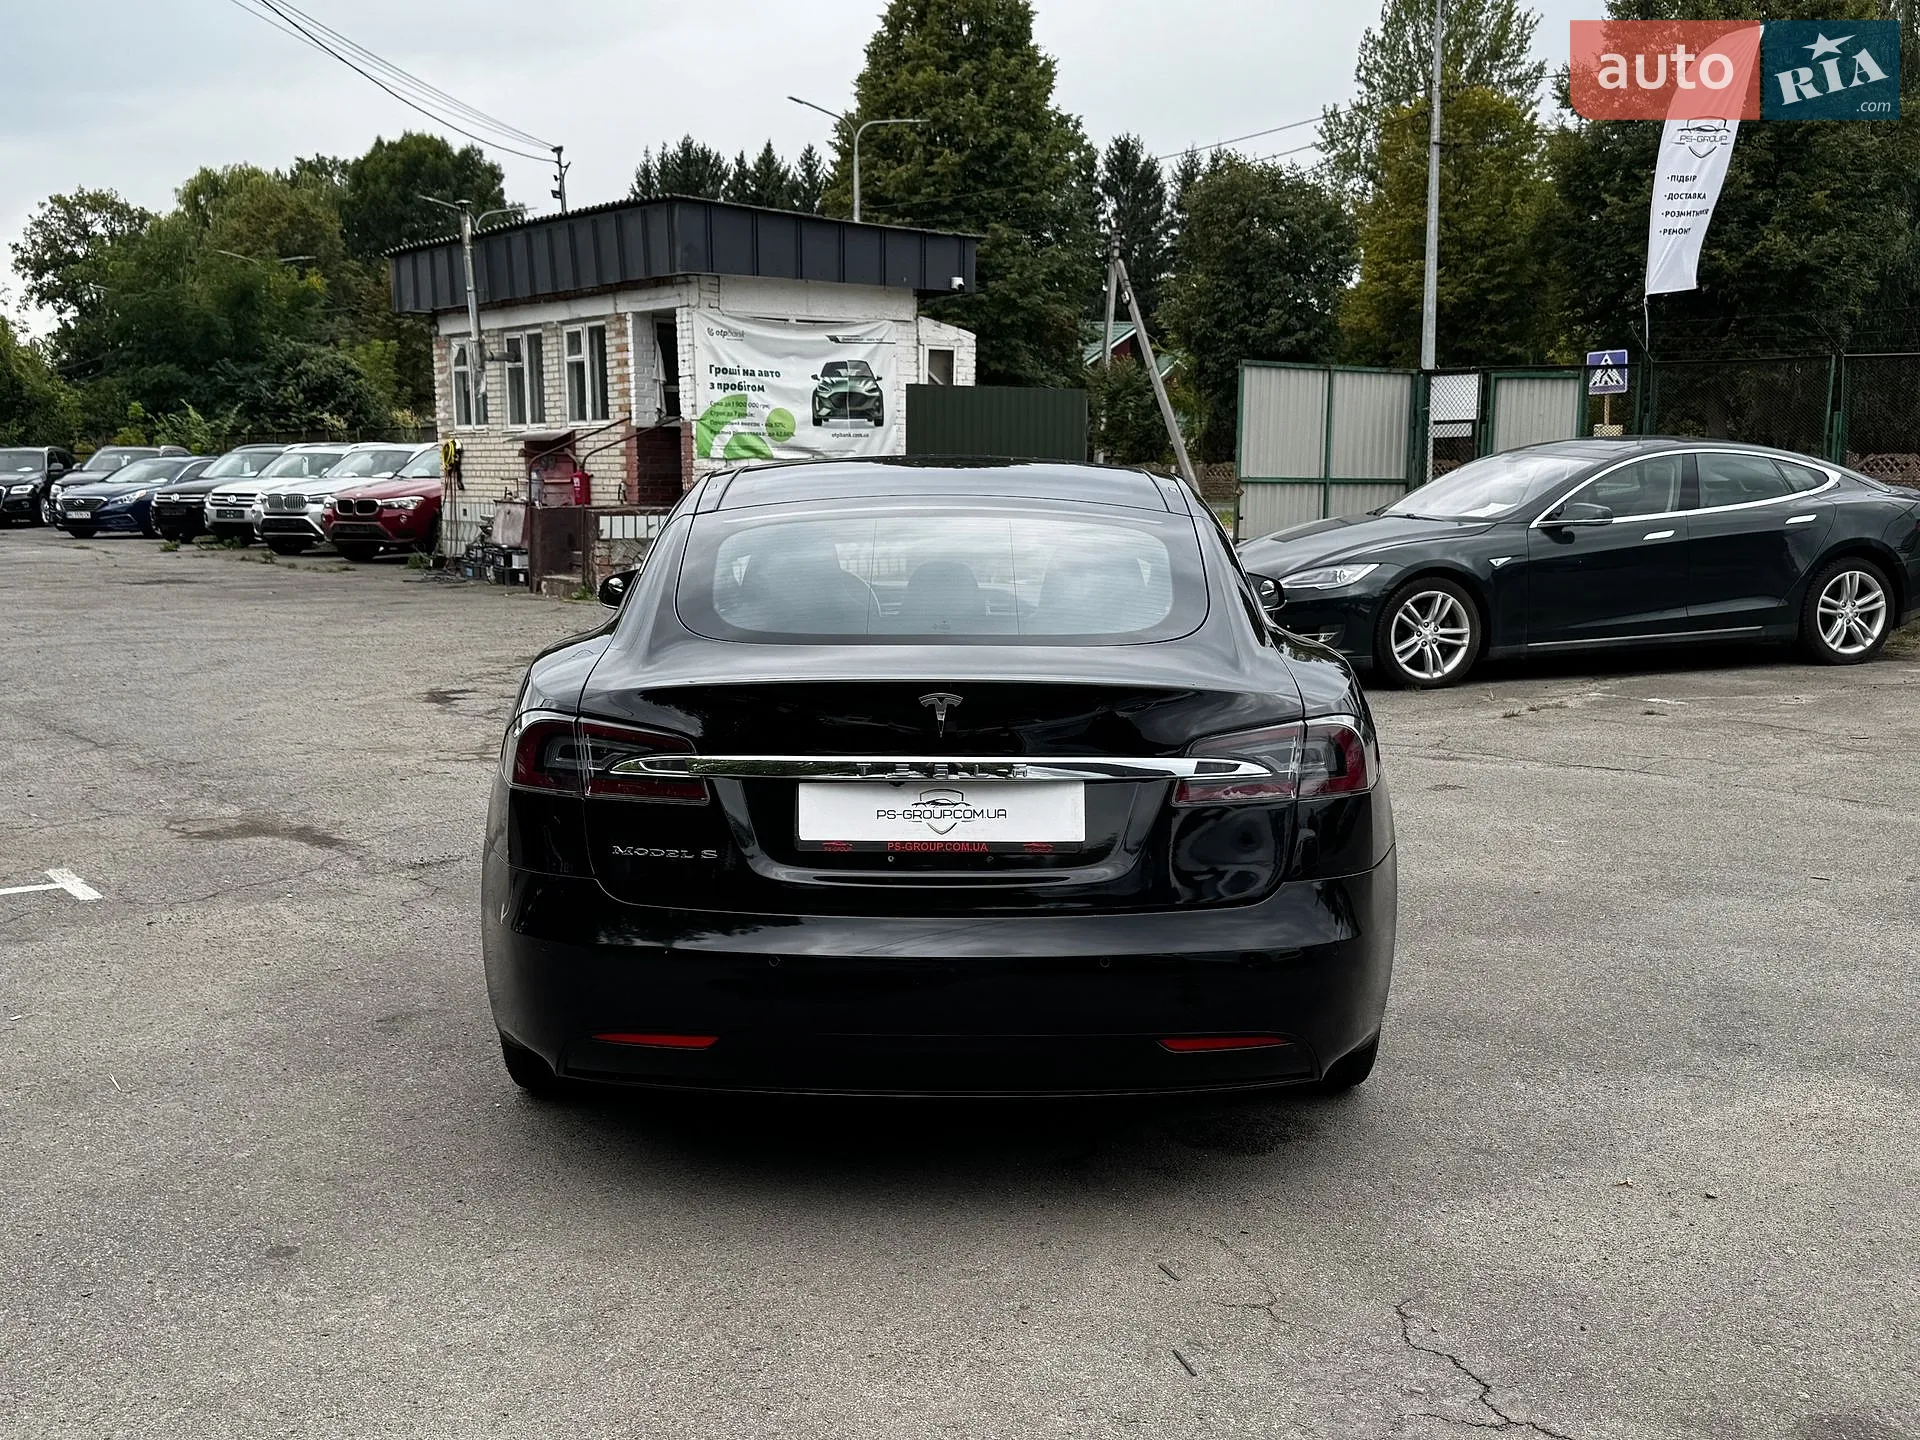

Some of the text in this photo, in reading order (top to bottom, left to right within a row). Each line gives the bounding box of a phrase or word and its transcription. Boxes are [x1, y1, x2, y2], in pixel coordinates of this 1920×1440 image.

[709, 364, 781, 378] Гроші на авто
[709, 380, 765, 392] з пробігом
[856, 763, 1028, 779] TESLA
[876, 808, 1007, 819] PS-GROUP.COM.UA
[612, 845, 718, 859] MODEL S
[887, 842, 988, 852] PS-GROUP.COM.UA
